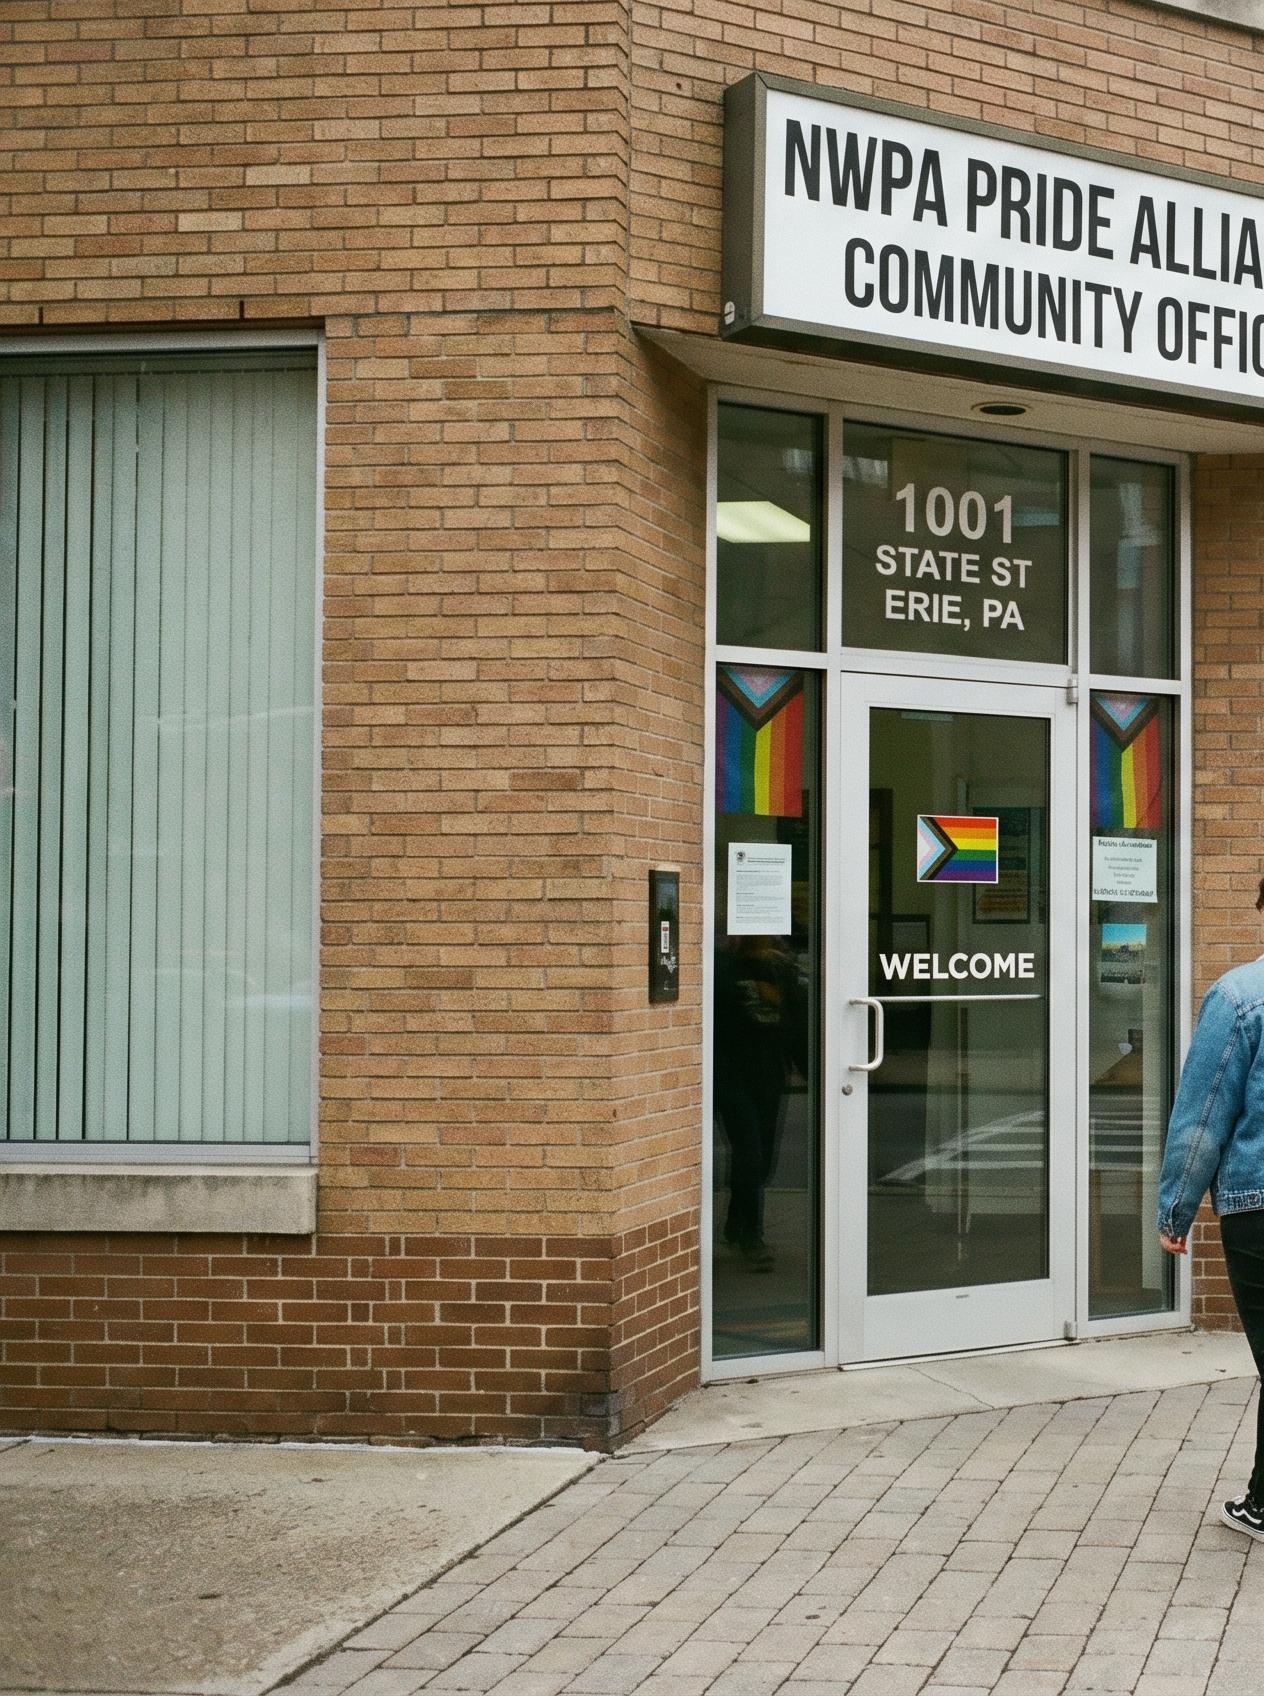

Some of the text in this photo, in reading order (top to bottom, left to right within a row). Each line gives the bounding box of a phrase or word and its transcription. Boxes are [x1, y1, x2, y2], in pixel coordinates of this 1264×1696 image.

[784, 119, 948, 228] NWPA
[966, 158, 1115, 260] PRIDE
[844, 238, 1143, 354] COMMUNITY
[895, 483, 1013, 544] 1001
[875, 545, 1033, 589] STATE ST
[885, 588, 1025, 631] ERIE, PA
[879, 952, 1035, 980] WELCOME
